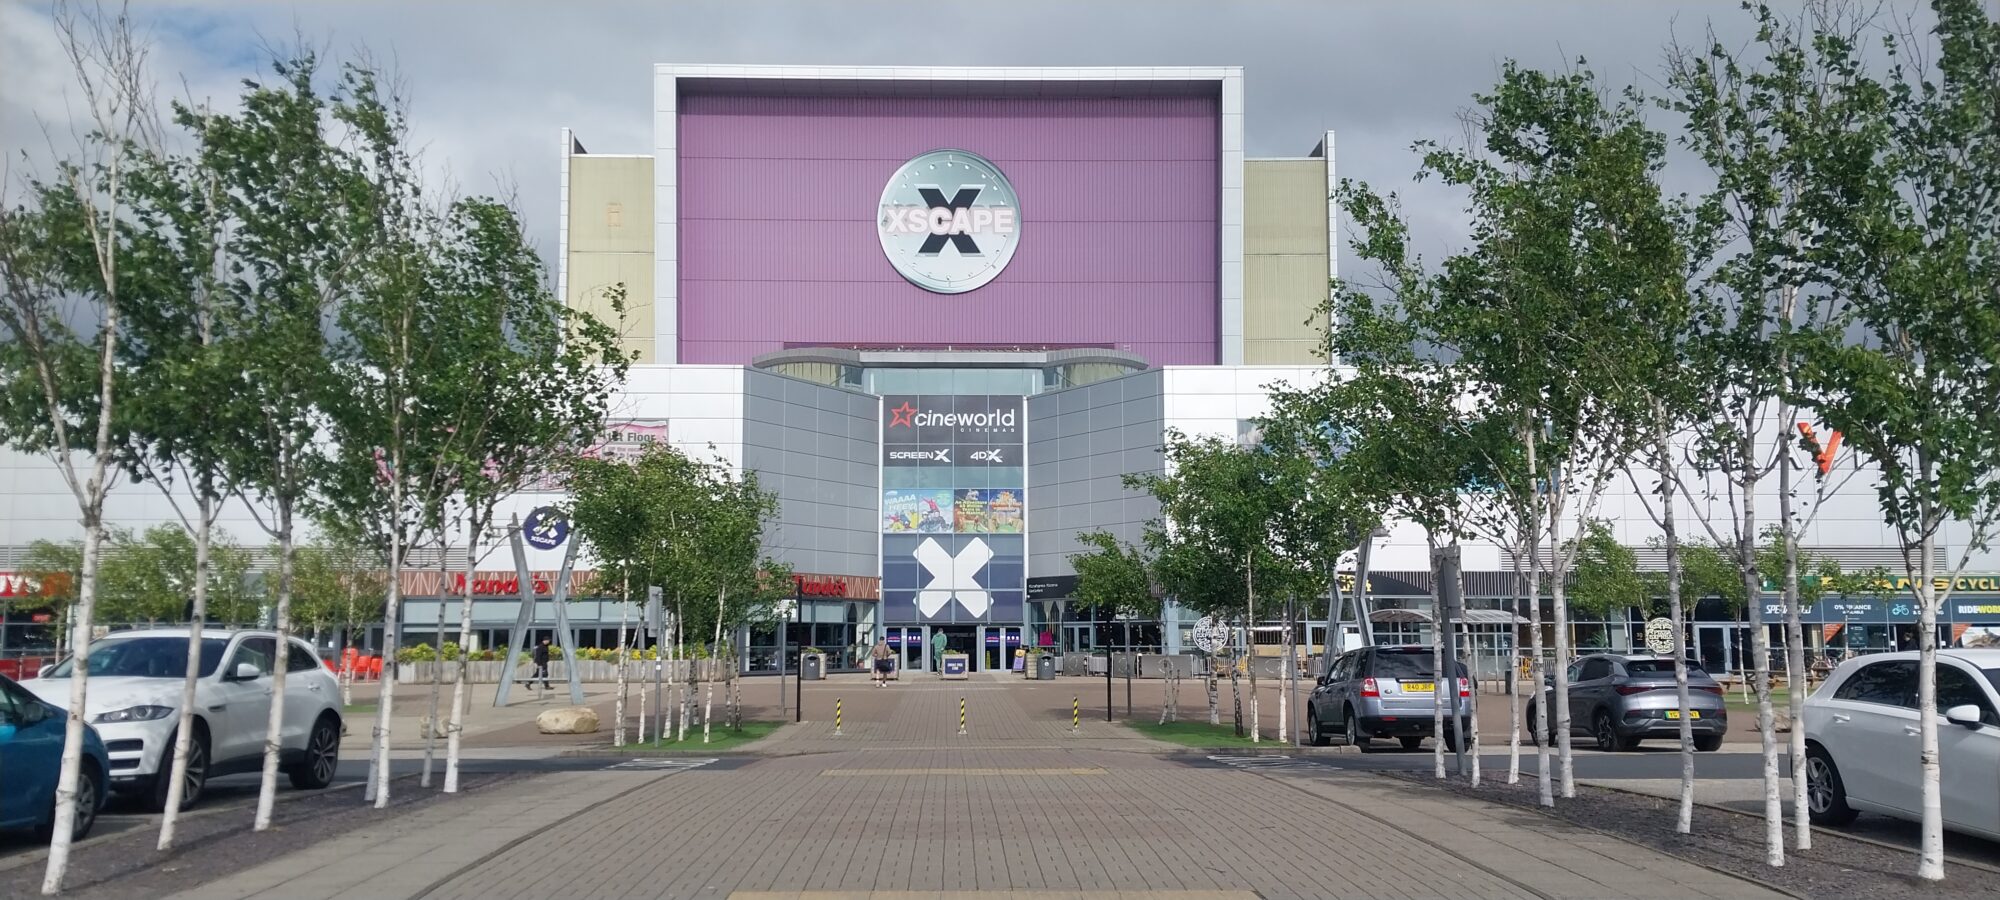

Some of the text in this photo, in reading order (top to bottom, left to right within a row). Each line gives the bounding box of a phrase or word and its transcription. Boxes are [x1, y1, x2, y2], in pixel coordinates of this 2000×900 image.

[885, 206, 1015, 235] XSCAPE
[914, 408, 1015, 427] cineworld
[627, 432, 656, 442] Floor
[889, 449, 952, 463] SCREENX
[970, 449, 1003, 463] 4DX
[530, 535, 557, 546] XSCAPE
[455, 573, 548, 594] Nand's
[1820, 577, 2000, 591] ANS CYCL
